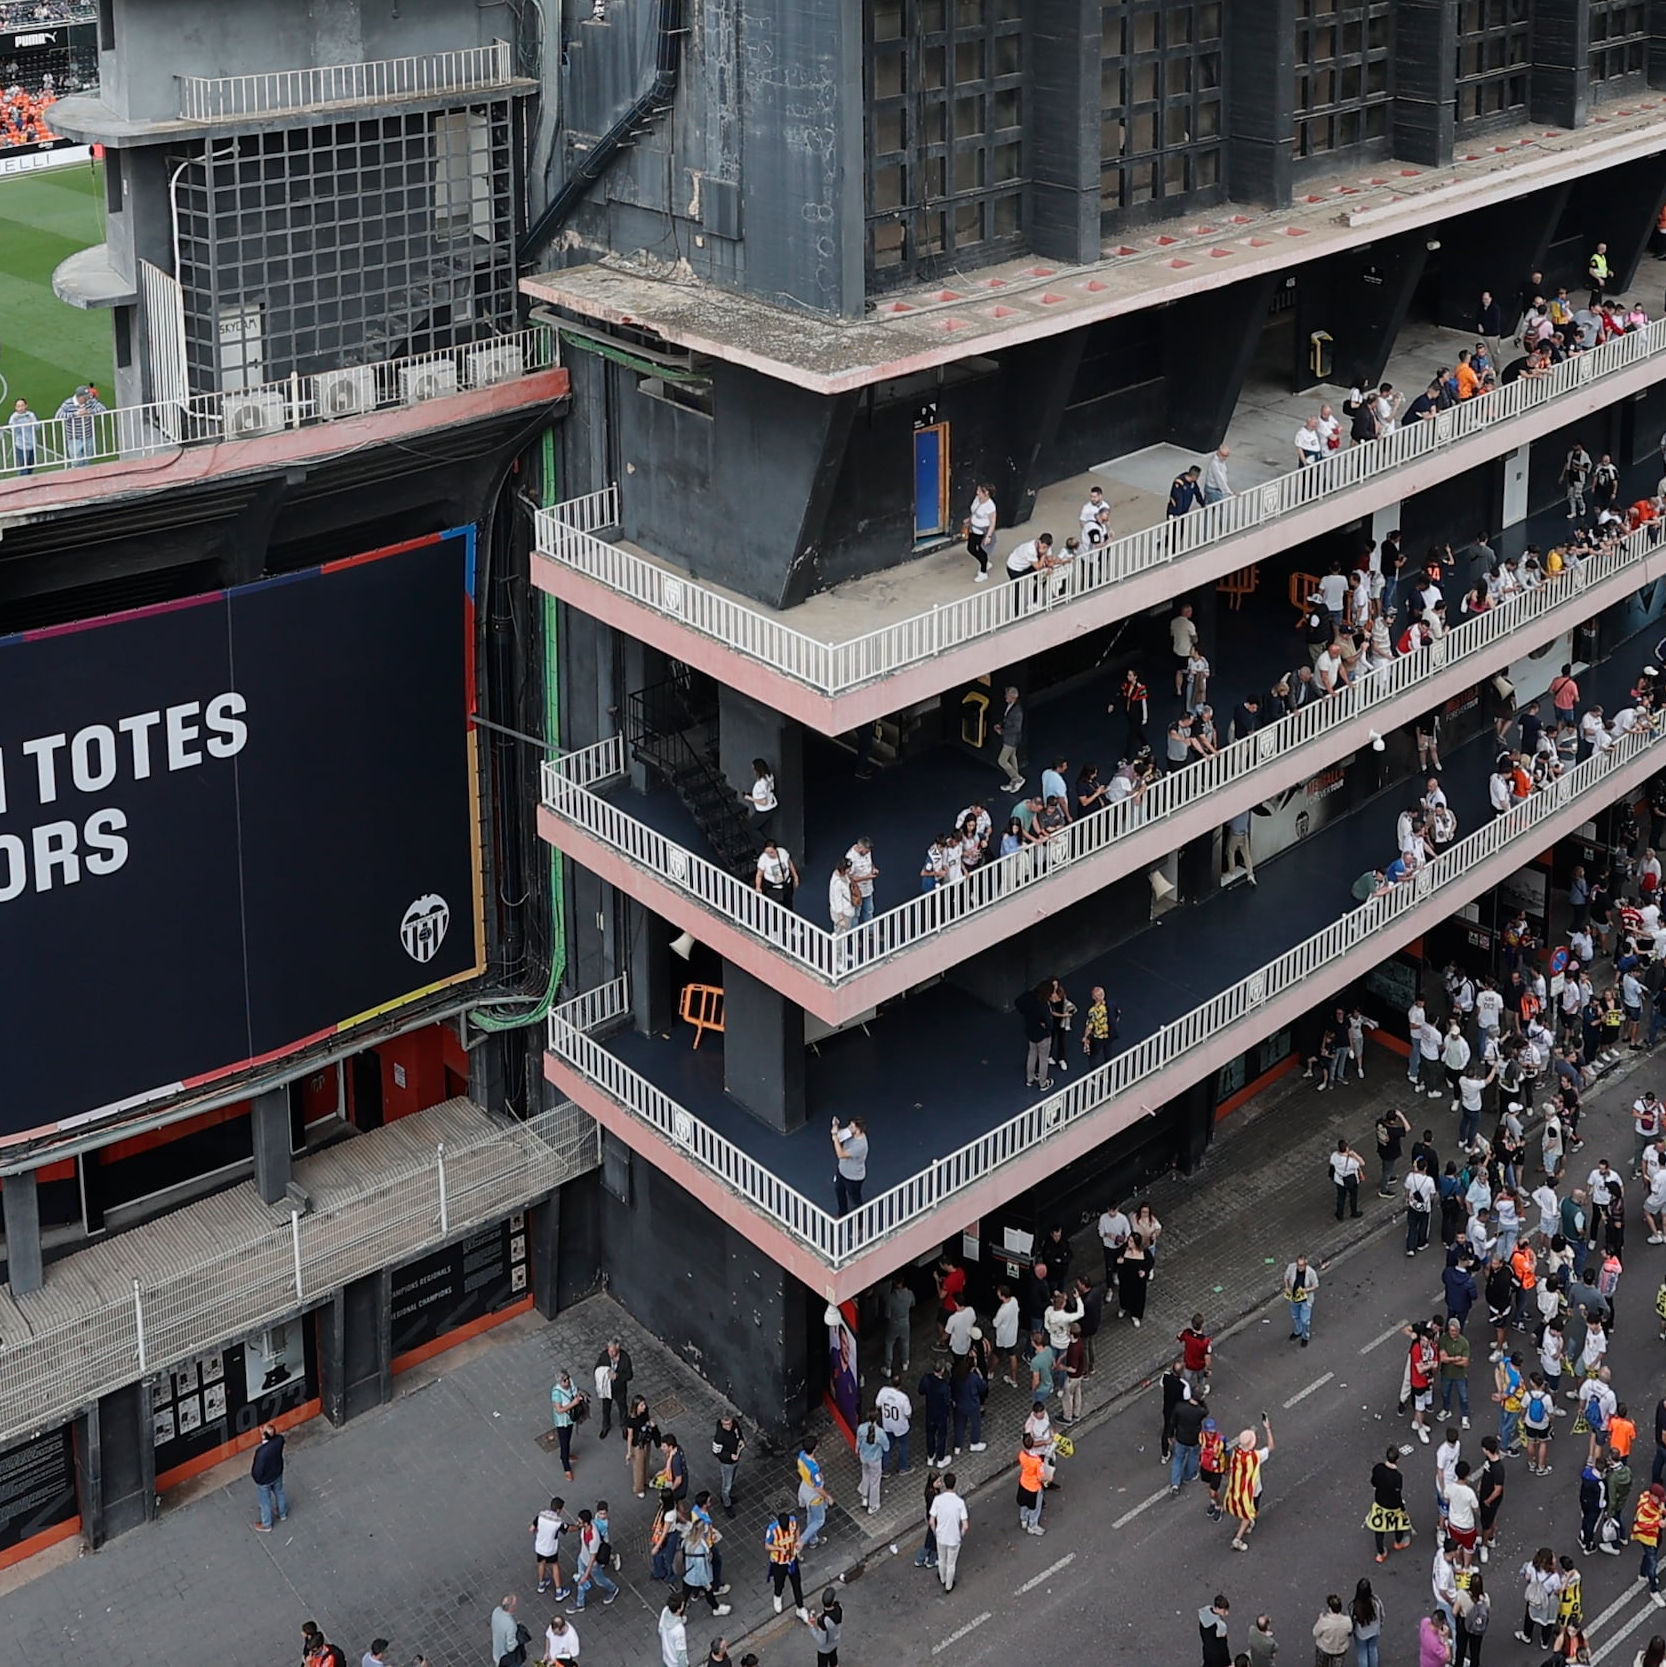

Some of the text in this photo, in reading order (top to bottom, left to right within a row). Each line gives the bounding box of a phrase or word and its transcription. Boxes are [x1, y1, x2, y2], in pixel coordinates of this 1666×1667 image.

[219, 318, 257, 335] SKYCAM
[23, 692, 248, 805] TOTES
[419, 1265, 452, 1286] REGIONALS
[418, 1286, 453, 1308] CHAMPIONS
[883, 1402, 899, 1422] 50
